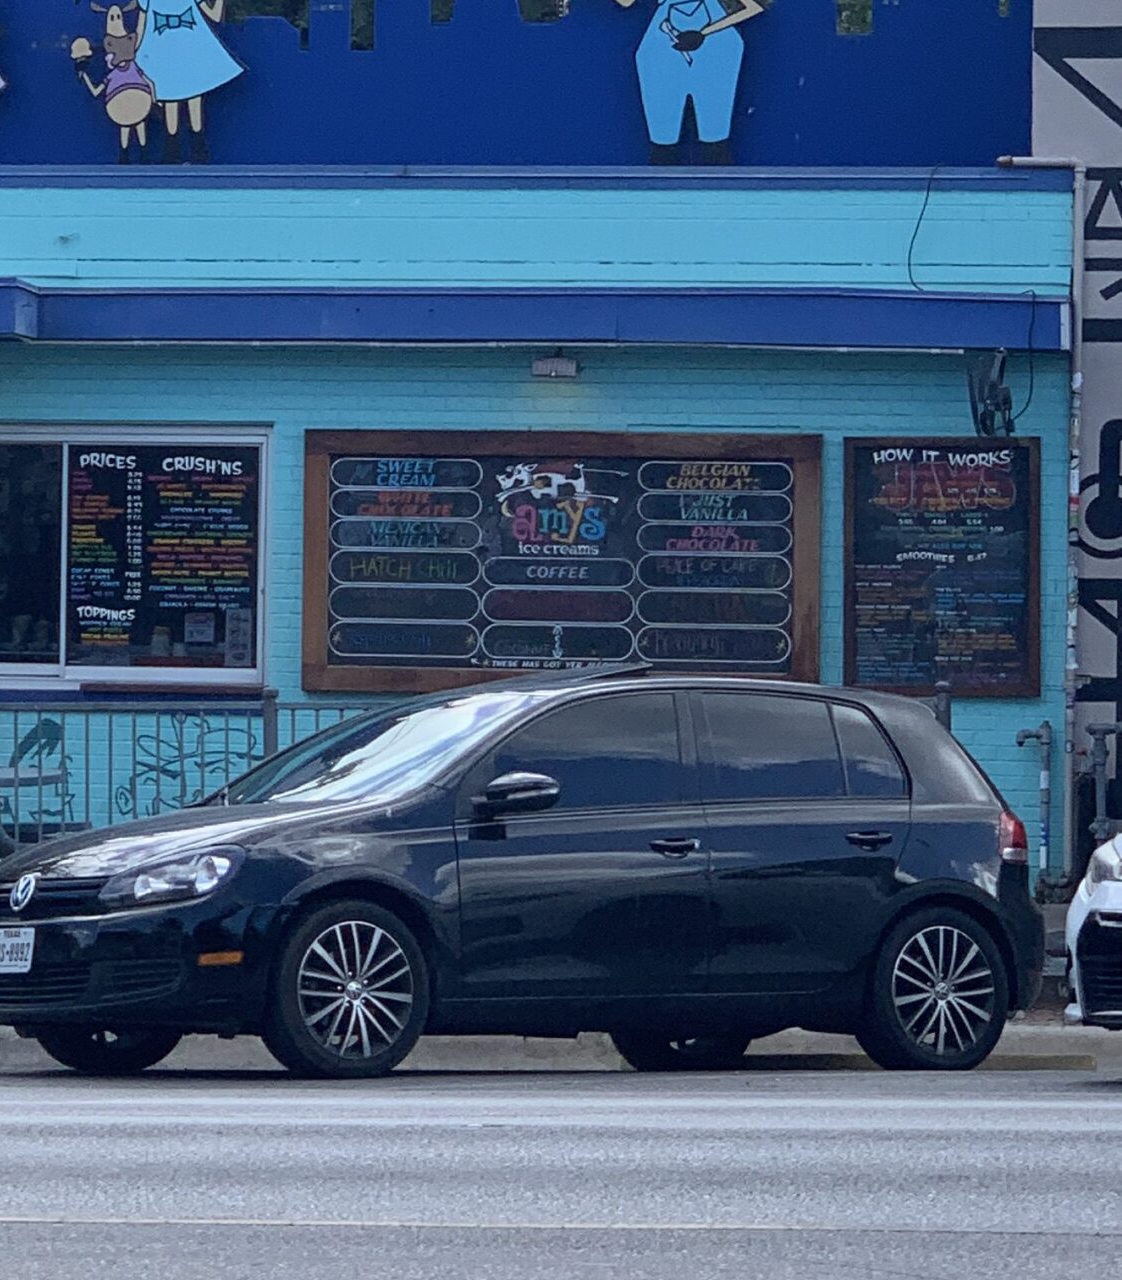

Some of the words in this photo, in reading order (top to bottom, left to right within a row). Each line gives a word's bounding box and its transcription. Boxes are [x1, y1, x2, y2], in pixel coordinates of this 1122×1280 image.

[79, 452, 137, 470] PRICES
[873, 448, 914, 464] HOW
[923, 450, 940, 463] IT
[162, 456, 243, 475] CRUSH'NS
[376, 459, 436, 473] SWEET
[680, 463, 751, 477] BELGIAN
[376, 474, 436, 487] CREAM
[692, 494, 737, 508] JUST
[680, 508, 749, 521] VANILLA
[368, 522, 440, 534] MEXICAN
[690, 526, 740, 539] DARK
[370, 534, 438, 547] VANILLA
[666, 538, 761, 551] CHOCOLATE
[518, 541, 541, 554] ice
[543, 543, 600, 556] creams
[896, 551, 956, 563] SMOOTHIES
[349, 555, 412, 579] HATCH
[526, 565, 590, 579] COFFEE
[76, 605, 136, 621] TOPPINGS
